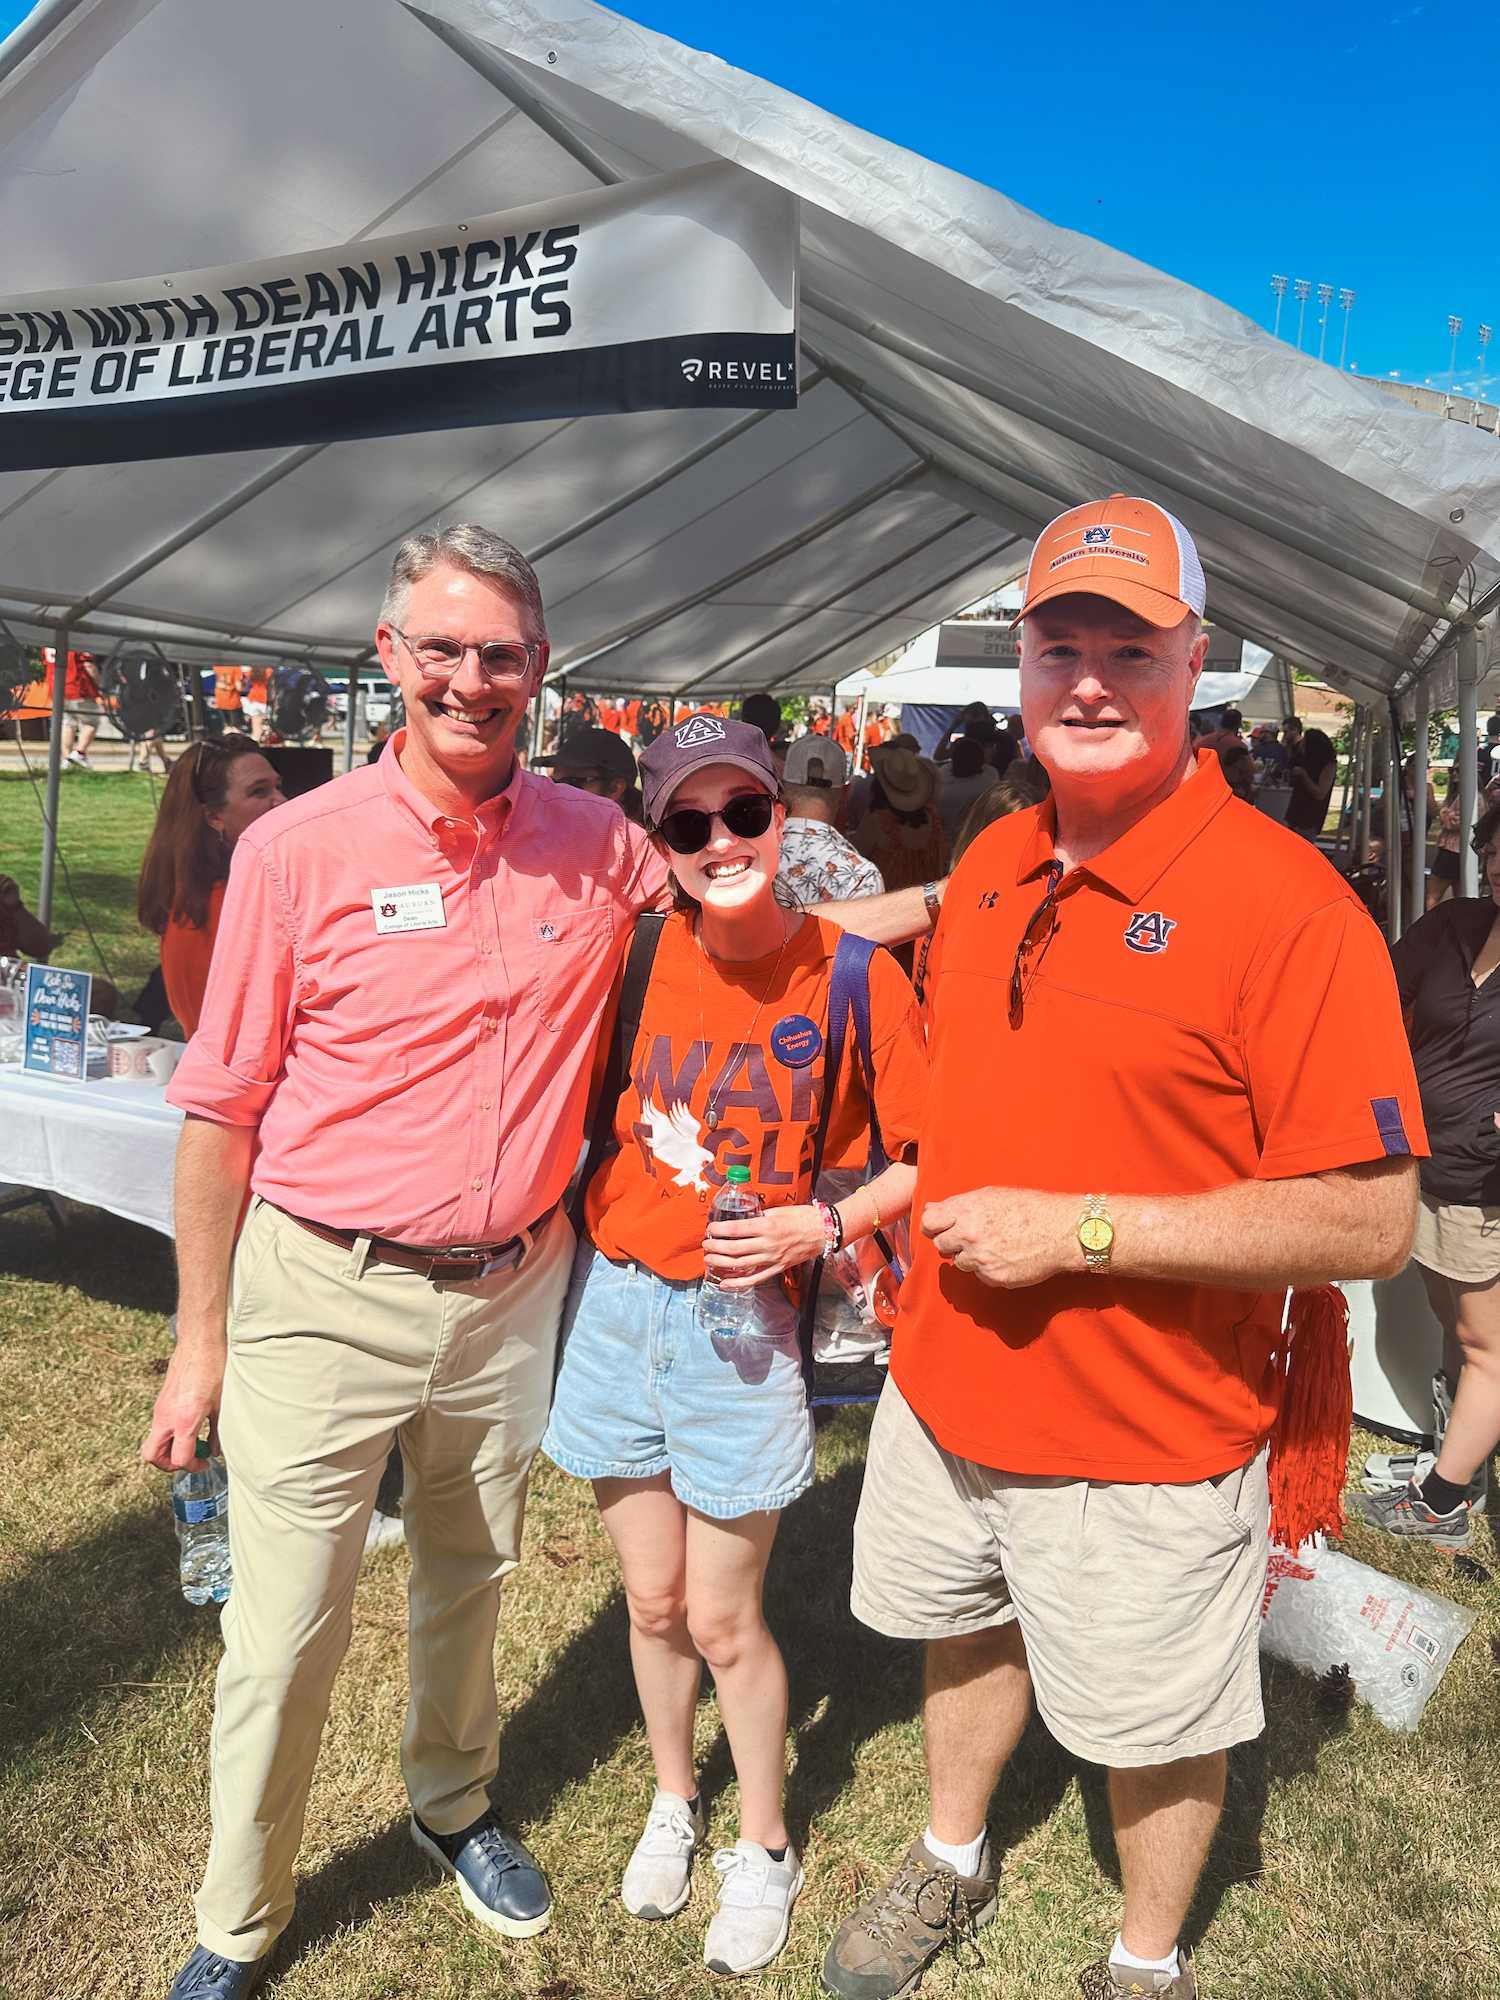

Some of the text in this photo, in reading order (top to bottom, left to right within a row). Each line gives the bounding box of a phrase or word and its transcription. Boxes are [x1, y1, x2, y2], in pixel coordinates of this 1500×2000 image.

[0, 224, 580, 356] SIX WITH DEAN HICKS
[90, 347, 161, 395] OF
[168, 314, 395, 388] LIBERAL
[407, 279, 572, 353] ARTS
[1050, 545, 1147, 570] Auburn University
